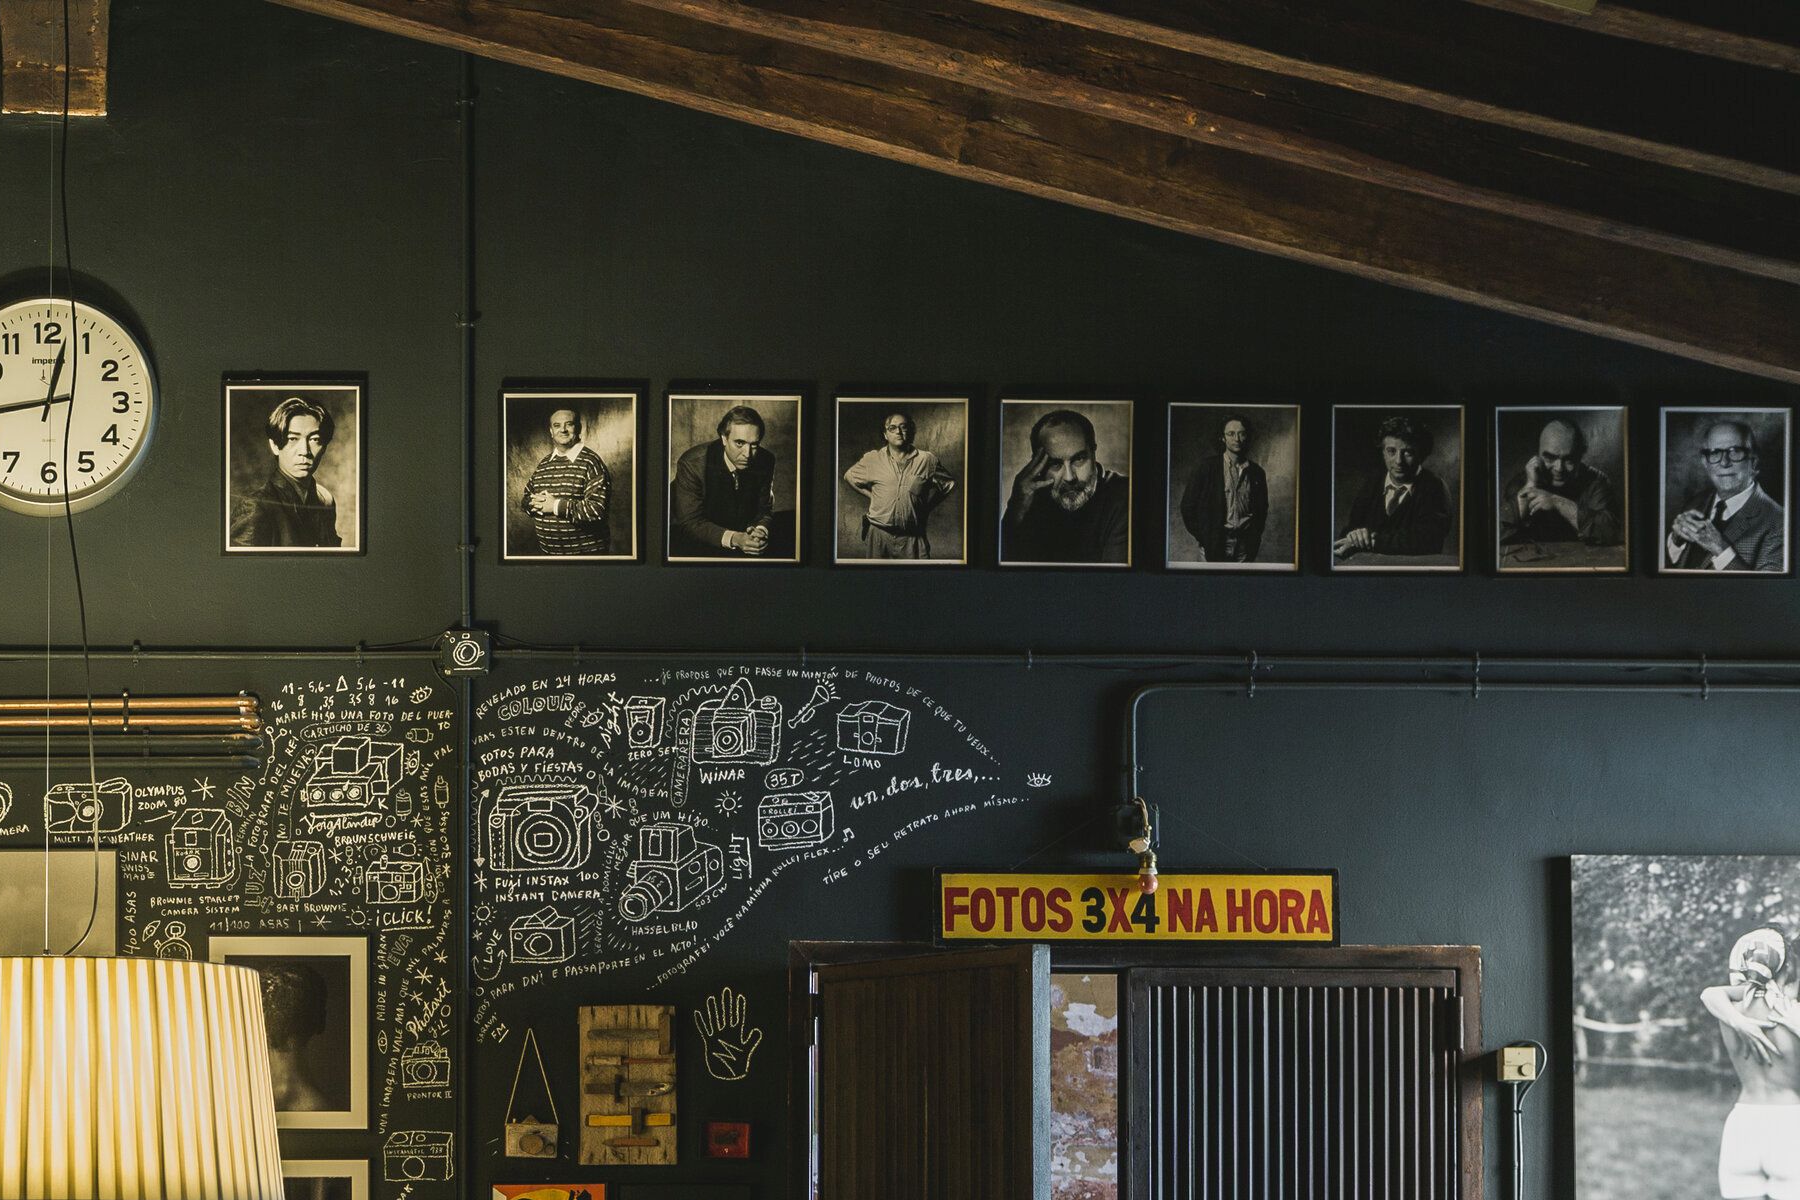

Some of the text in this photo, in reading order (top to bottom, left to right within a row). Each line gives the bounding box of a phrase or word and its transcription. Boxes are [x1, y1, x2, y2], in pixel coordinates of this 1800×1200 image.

[2, 333, 20, 354] 11
[33, 322, 62, 344] 12
[82, 333, 90, 354] 1
[101, 360, 119, 381] 2
[112, 391, 130, 413] 3
[101, 424, 120, 445] 4
[2, 451, 20, 473] 7
[40, 462, 58, 483] 6
[77, 451, 95, 473] 5
[298, 694, 305, 707] 8
[368, 693, 376, 706] 8
[385, 695, 399, 706] 16
[475, 672, 617, 720] REVELADO EN 24 HORAS
[497, 692, 576, 721] COLOUR
[675, 669, 710, 680] PROPOSE
[716, 666, 734, 676] QUE
[739, 665, 750, 675] TU
[787, 669, 799, 678] UN
[845, 670, 858, 679] DE
[865, 671, 901, 693] PHOTOS
[906, 686, 922, 698] DE
[922, 696, 936, 708] CE
[934, 706, 951, 722] QUE
[953, 718, 967, 733] TU
[275, 708, 422, 726] MARIE UNA FOTO DEL
[564, 701, 586, 729] PEDRO
[303, 723, 351, 739] CARTUCHO
[357, 723, 369, 732] DE
[438, 721, 451, 731] TO
[501, 726, 536, 737] ESTEN
[543, 727, 586, 749] DENTRO
[480, 747, 554, 765] FOTOS PARA
[627, 750, 653, 762] ZERO
[843, 755, 882, 770] LOMO
[271, 763, 288, 785] DEL
[477, 762, 516, 782] BODAS
[534, 760, 584, 774] FIESTAS
[134, 784, 184, 797] OLYMPUS
[277, 748, 315, 839] NO TE MUEVAS
[138, 796, 188, 811] ZOOM 80
[439, 811, 450, 835] ASAS
[629, 811, 671, 828] QUE UM
[53, 835, 81, 844] MULTI
[867, 842, 890, 860] SEU
[893, 814, 939, 841] RETRATO
[944, 803, 977, 819] AHORA
[119, 850, 159, 863] SINAR
[120, 864, 148, 873] SWISS
[526, 876, 570, 886] INSTAX
[576, 871, 600, 882] 100
[151, 894, 240, 908] BROWNIE STARLET
[495, 889, 600, 903] INSTANT CAMERA
[161, 905, 240, 917] CAMERA SISTEM
[276, 902, 347, 913] BABY BROWNIE
[944, 887, 1331, 935] FOTOS 3X4 NA HORA
[122, 891, 141, 954] 400 ASAS
[631, 920, 698, 936] HASSELBLAD
[379, 975, 387, 985] IN
[490, 982, 515, 1000] PARA
[565, 957, 632, 977] PASSAPORTE
[635, 952, 646, 965] EN
[653, 947, 665, 958] EL
[376, 990, 387, 1021] MADE
[392, 1027, 404, 1053] VALE
